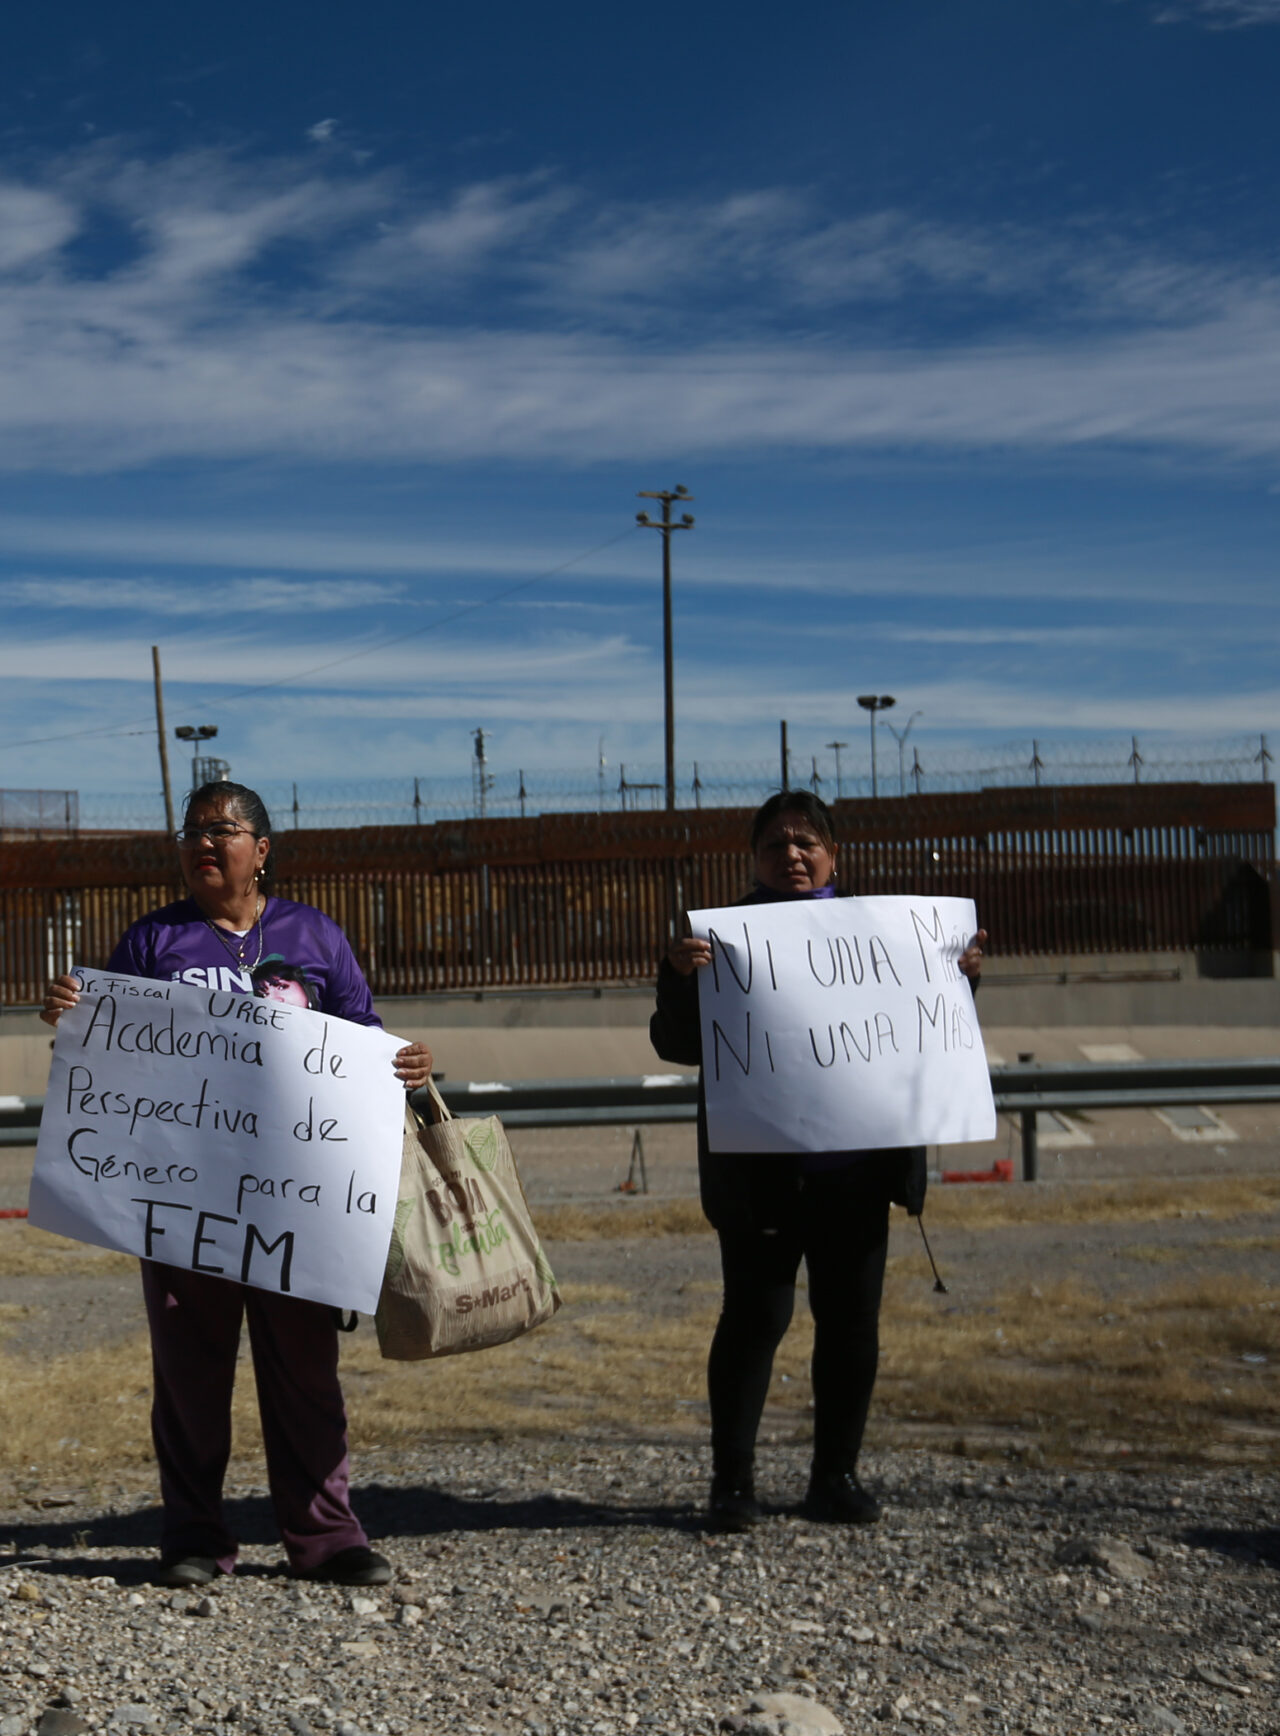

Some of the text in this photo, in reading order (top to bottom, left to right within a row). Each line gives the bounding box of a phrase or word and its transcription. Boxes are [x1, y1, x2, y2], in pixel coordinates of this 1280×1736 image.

[708, 922, 777, 994] NI
[807, 935, 902, 988] UNA
[82, 995, 347, 1079] Academia de
[103, 978, 170, 1000] Fiscal
[208, 992, 292, 1031] URGE
[713, 1012, 774, 1081] NI
[809, 1012, 899, 1068] UNA
[67, 1066, 348, 1142] Perspectiva de
[68, 1128, 376, 1214] Género para la
[131, 1198, 294, 1292] FEM
